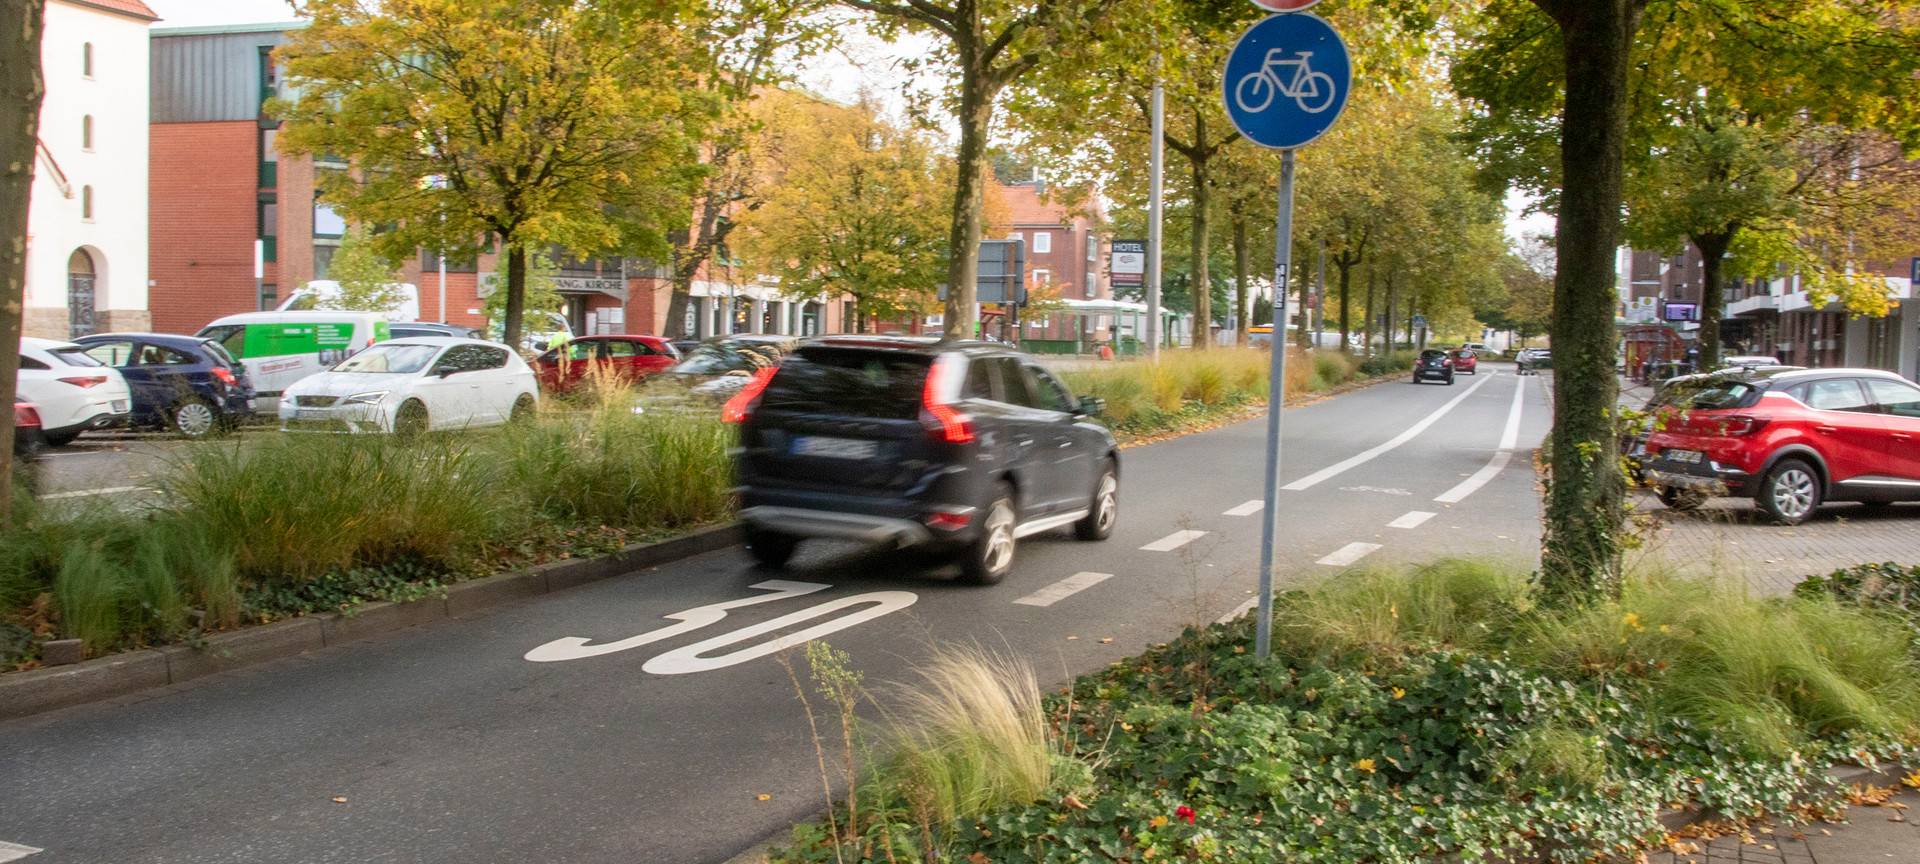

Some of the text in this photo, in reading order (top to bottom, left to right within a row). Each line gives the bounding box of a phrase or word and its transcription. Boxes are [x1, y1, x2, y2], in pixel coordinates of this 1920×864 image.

[1113, 243, 1144, 252] HOTEL
[585, 279, 623, 290] KIRCHE
[524, 579, 918, 675] 30
